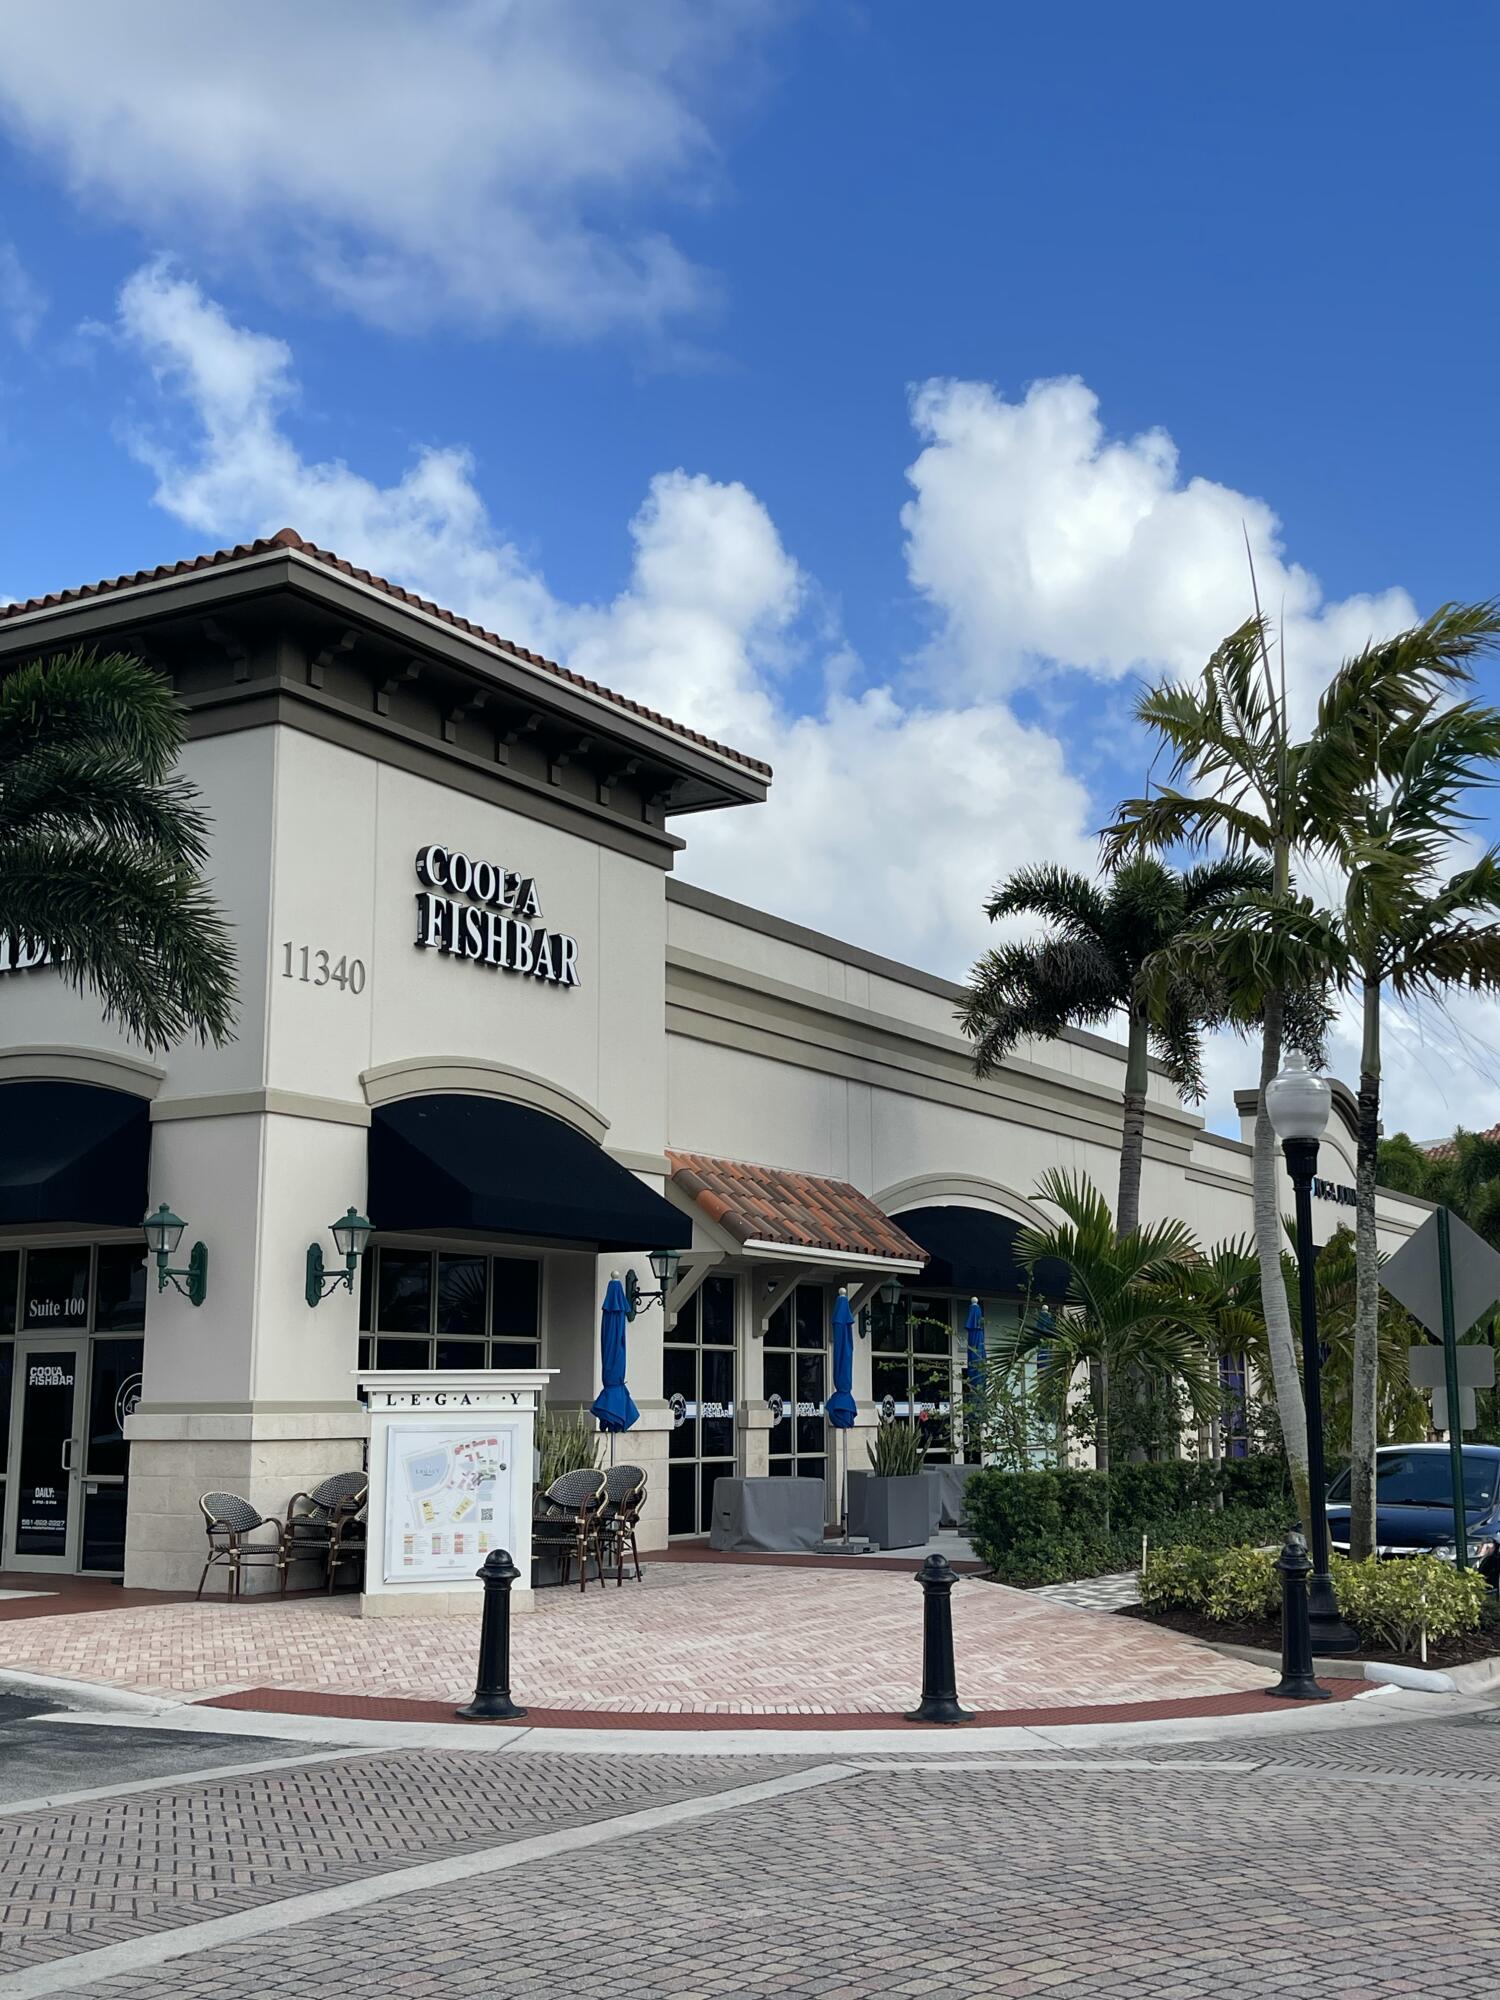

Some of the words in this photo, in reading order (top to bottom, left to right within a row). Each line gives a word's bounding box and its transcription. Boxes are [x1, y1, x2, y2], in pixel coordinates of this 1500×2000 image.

[416, 844, 544, 919] COOL'A
[414, 892, 582, 988] FISHBAR
[282, 941, 366, 995] 11340
[29, 1298, 61, 1317] Suite
[63, 1296, 86, 1316] 100
[28, 1375, 74, 1386] FISHBAR
